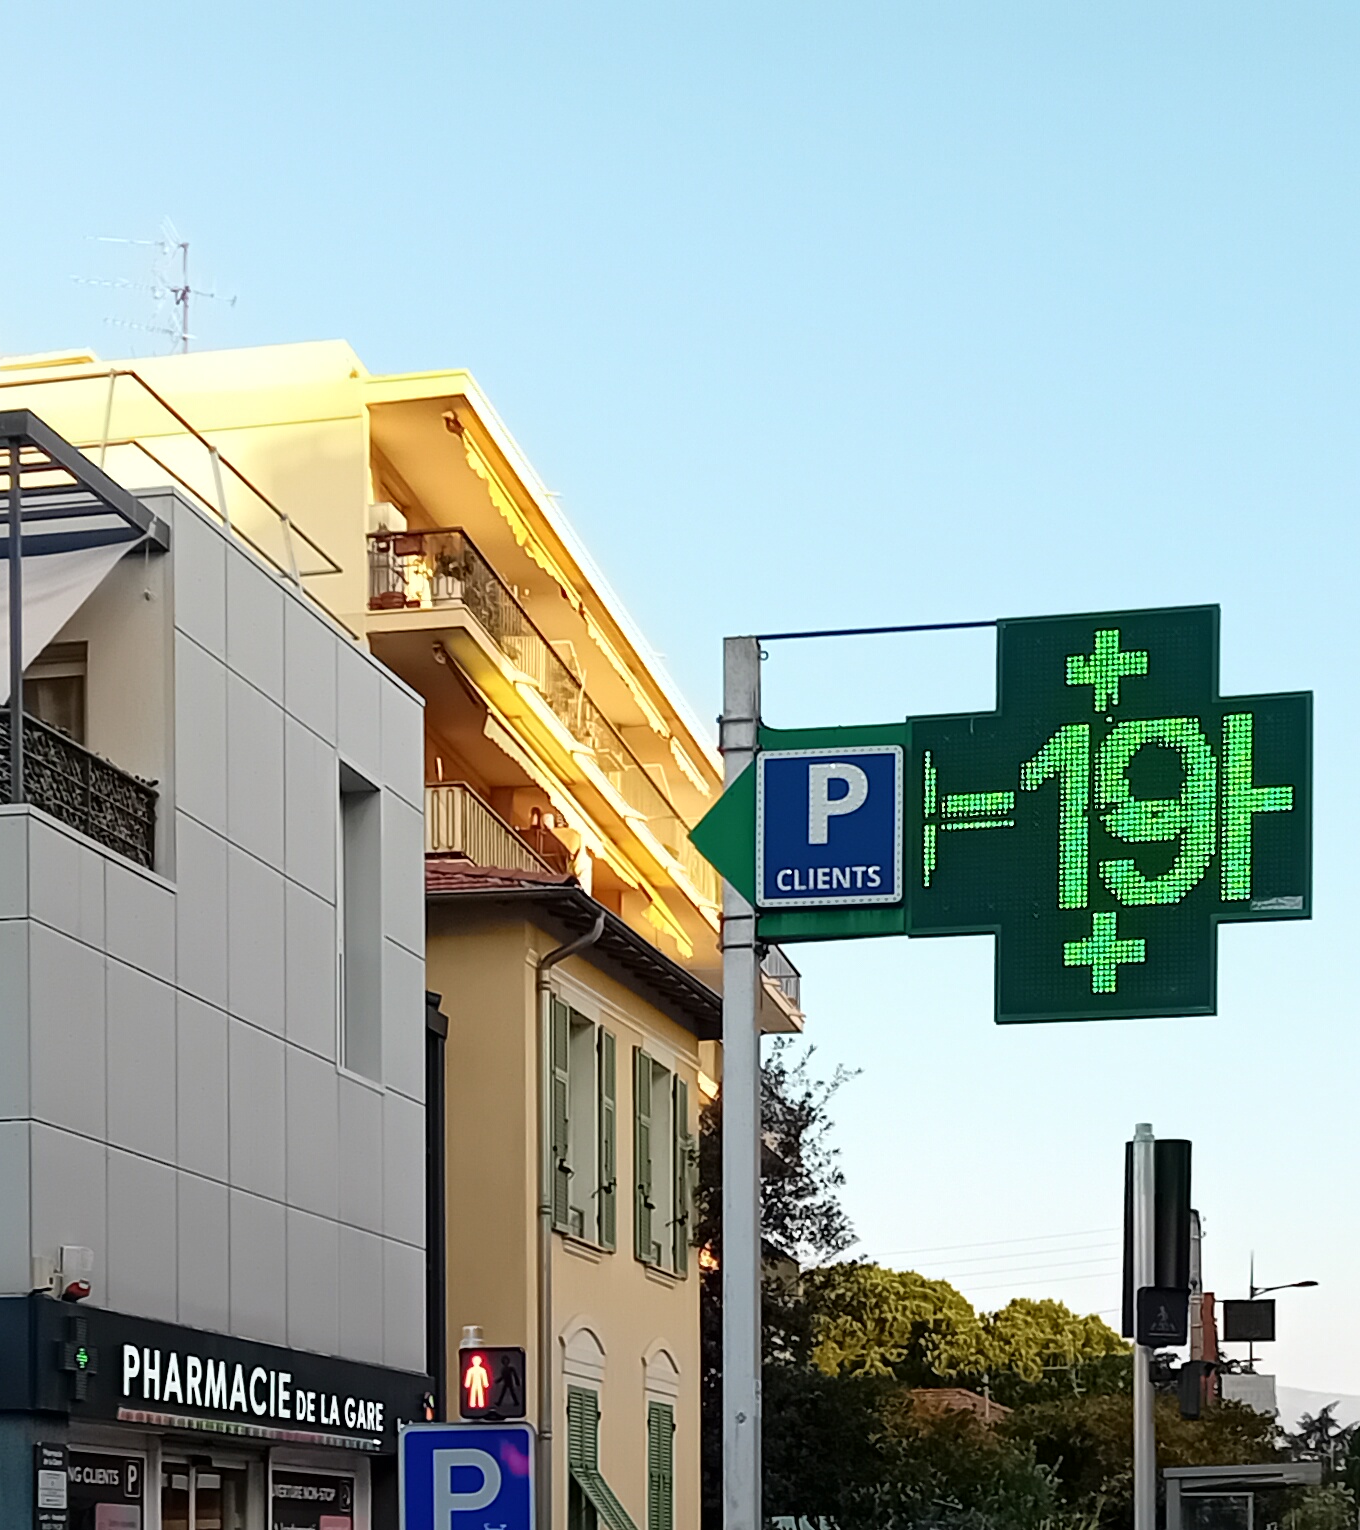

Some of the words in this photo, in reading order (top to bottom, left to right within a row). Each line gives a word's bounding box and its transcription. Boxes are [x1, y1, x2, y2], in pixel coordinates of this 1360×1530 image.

[808, 762, 869, 845] P
[776, 865, 881, 891] CLIENTS
[123, 1343, 292, 1419] PHARMACIE
[296, 1389, 316, 1423] DE
[320, 1393, 341, 1427] LA
[344, 1397, 384, 1432] GARE
